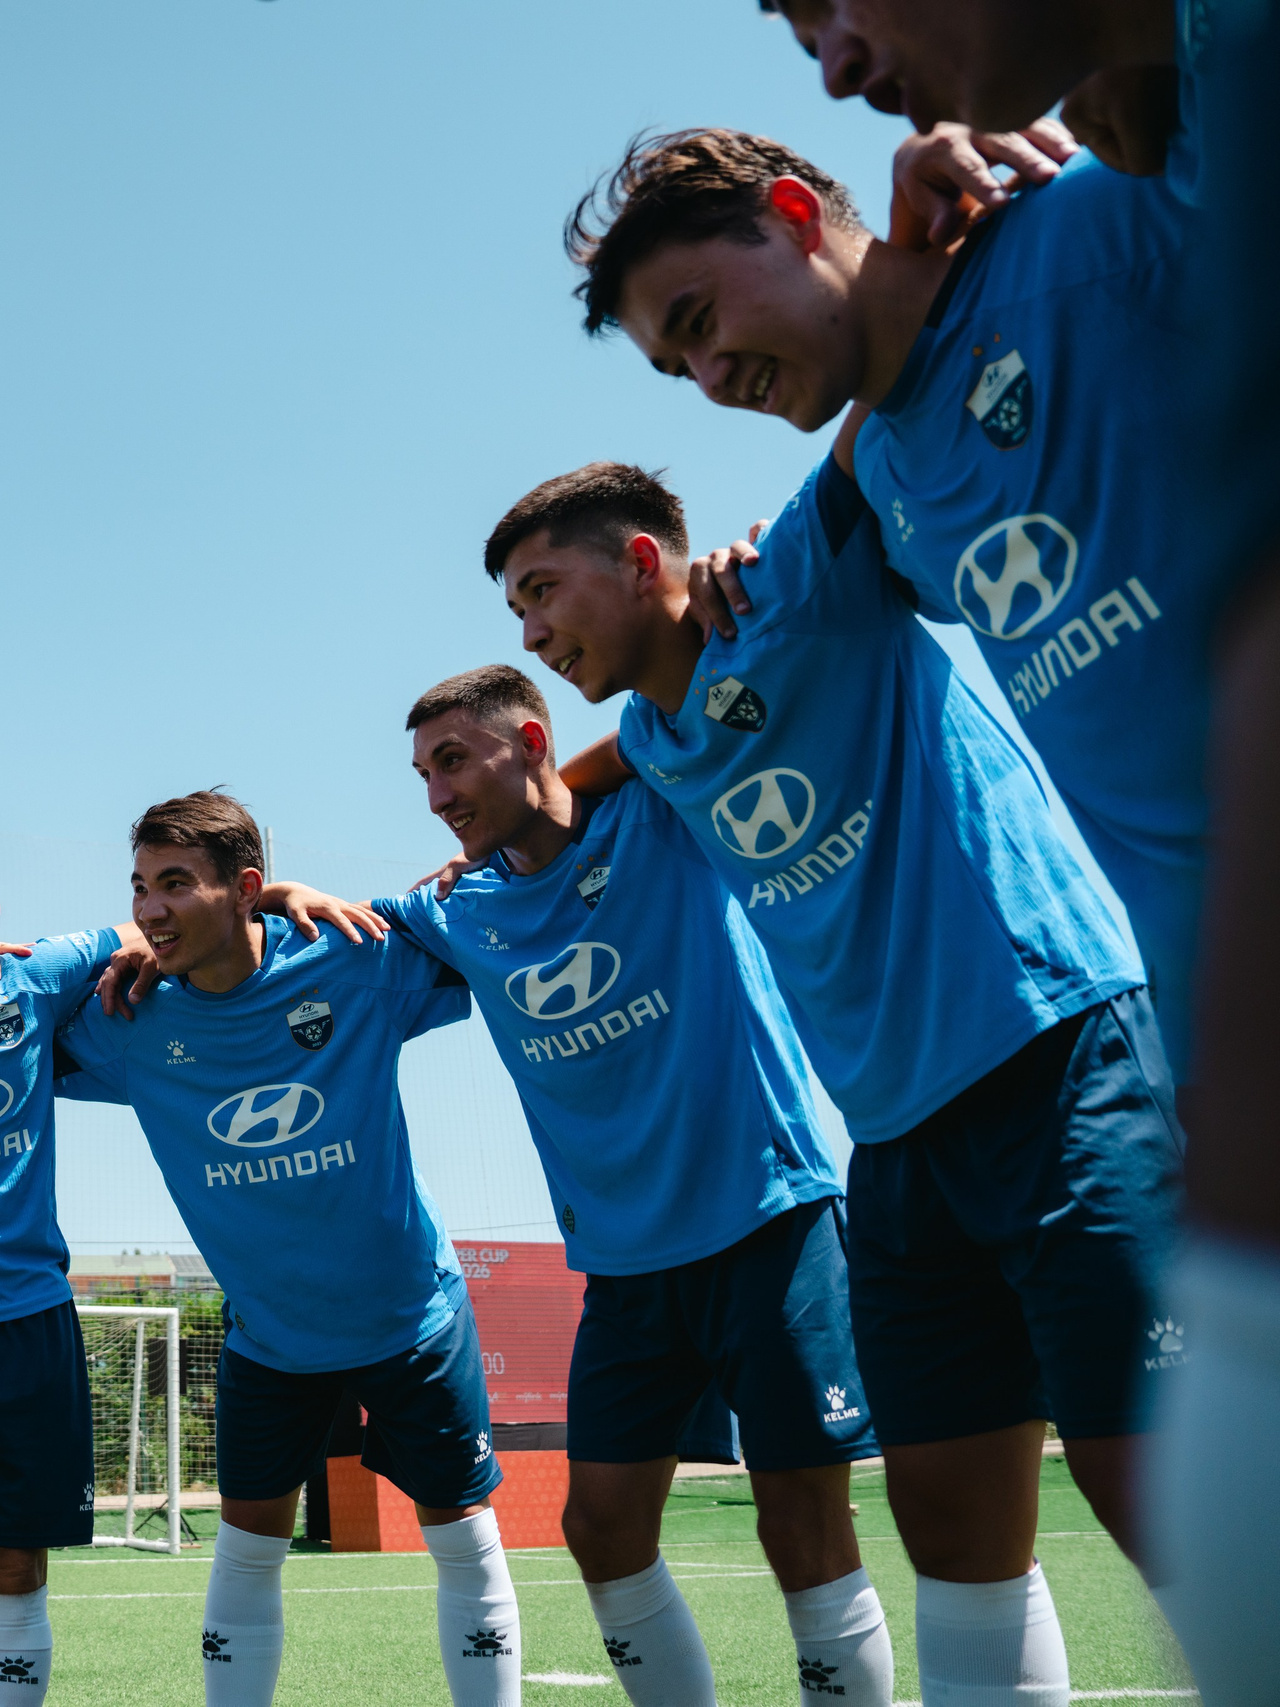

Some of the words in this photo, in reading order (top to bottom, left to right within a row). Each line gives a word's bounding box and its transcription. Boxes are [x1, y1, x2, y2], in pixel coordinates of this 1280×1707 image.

[1008, 575, 1162, 717] HYUNDAI
[748, 799, 873, 909] HYUNDA
[478, 943, 510, 951] KELME
[520, 988, 671, 1063] HYUNDAI
[166, 1056, 197, 1065] KELME
[204, 1140, 356, 1187] HYUNDAI
[480, 1248, 509, 1263] CUP
[462, 1263, 491, 1279] 026
[823, 1407, 861, 1423] KELME
[462, 1648, 513, 1658] KELME
[610, 1656, 643, 1668] LME
[799, 1677, 846, 1696] ELME
